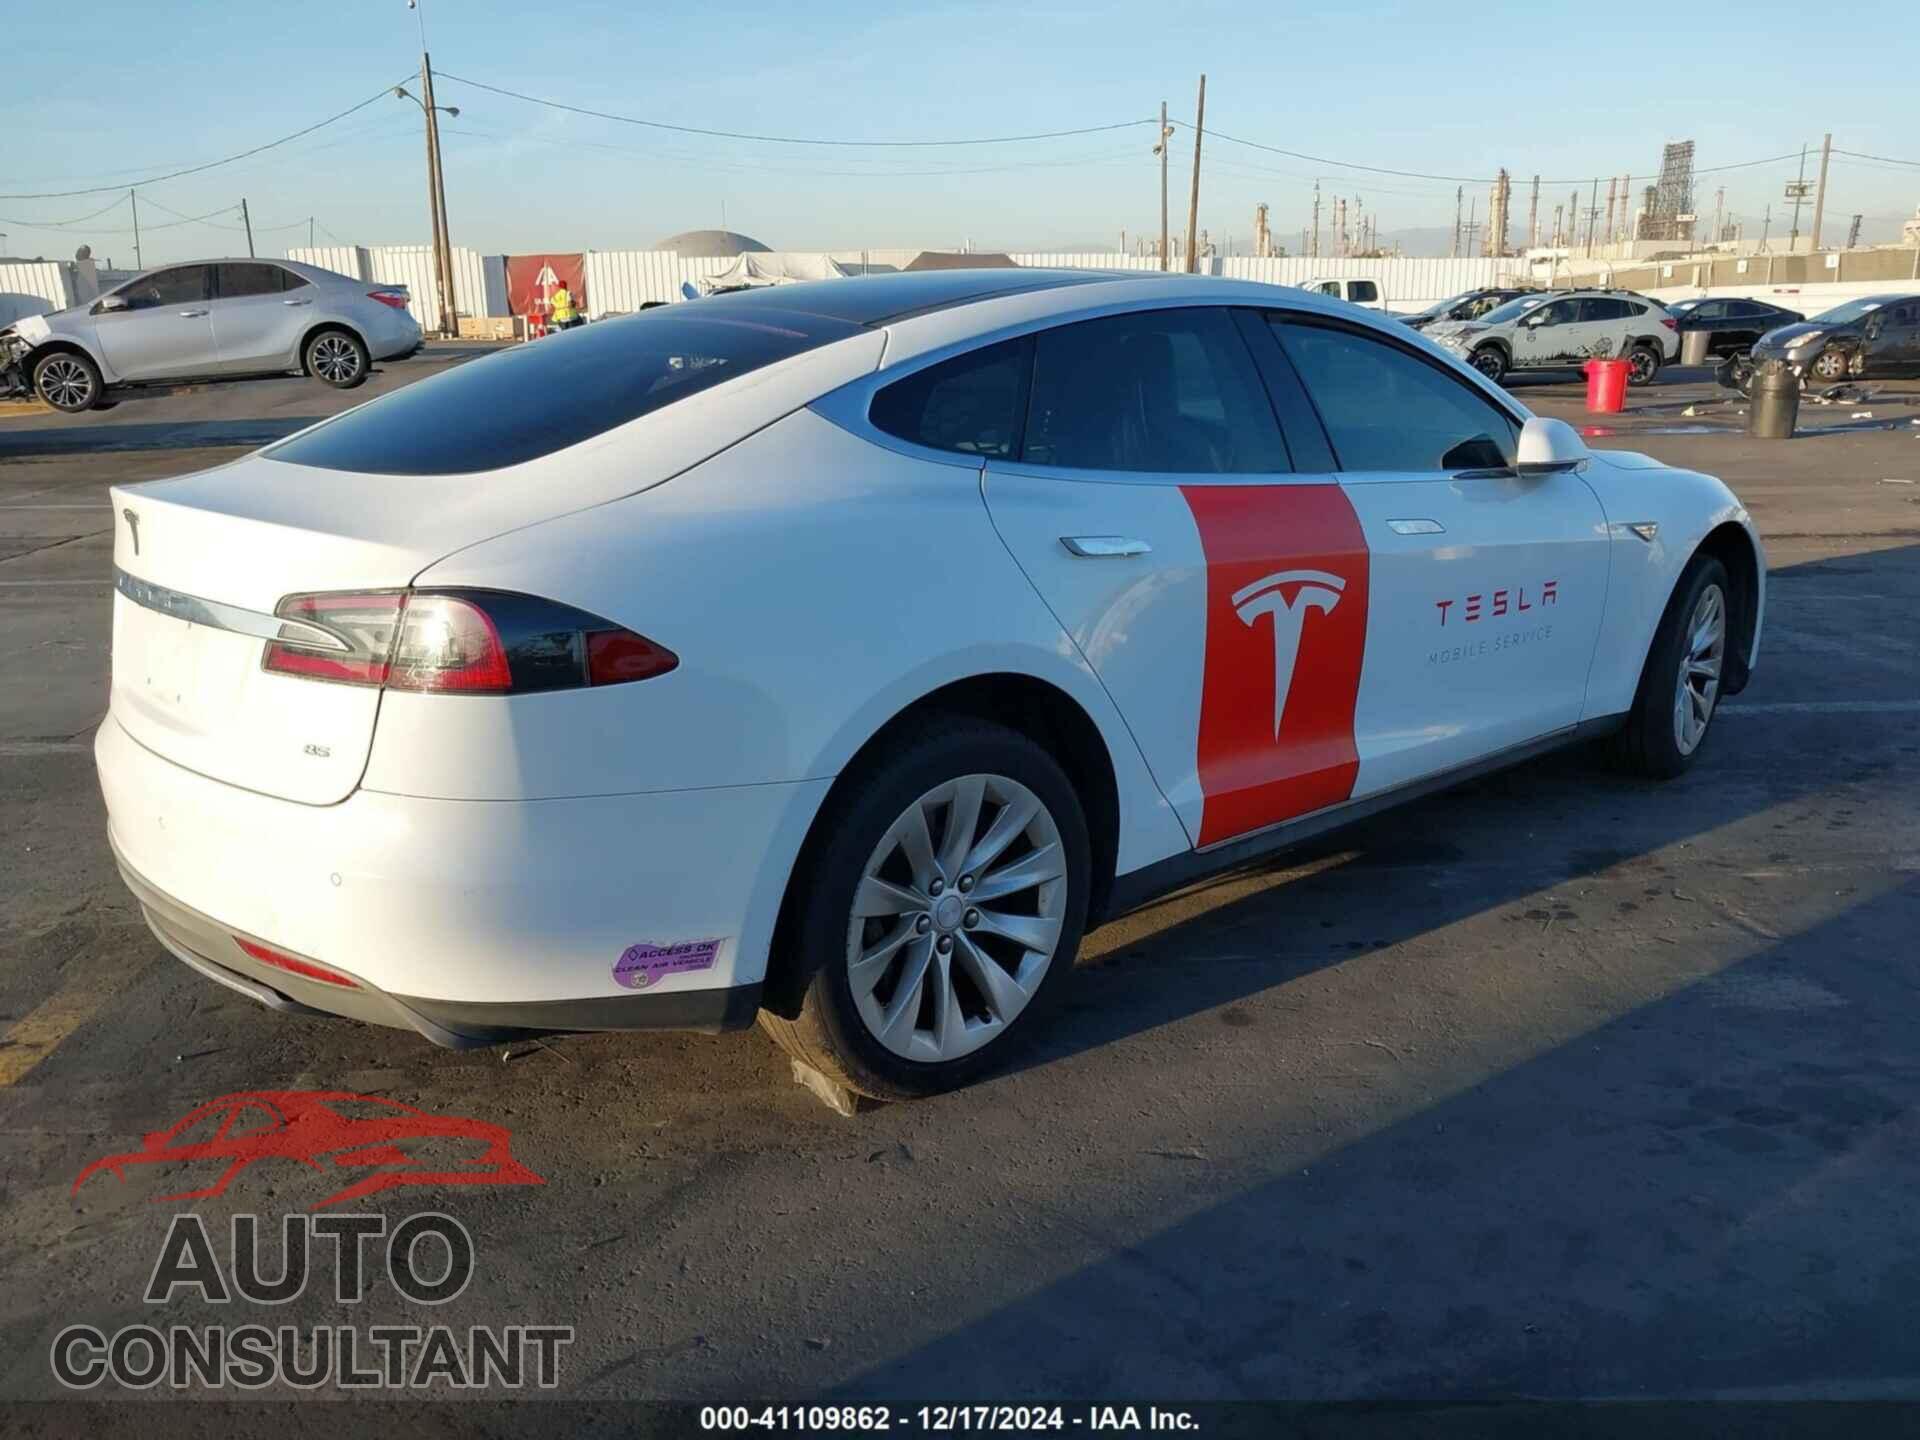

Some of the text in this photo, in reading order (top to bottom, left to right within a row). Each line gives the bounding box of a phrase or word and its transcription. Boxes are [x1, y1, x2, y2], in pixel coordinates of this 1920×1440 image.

[1436, 580, 1557, 627] TESLA
[1428, 624, 1553, 665] MOBILE SERVICE
[639, 944, 692, 960] ACCESS
